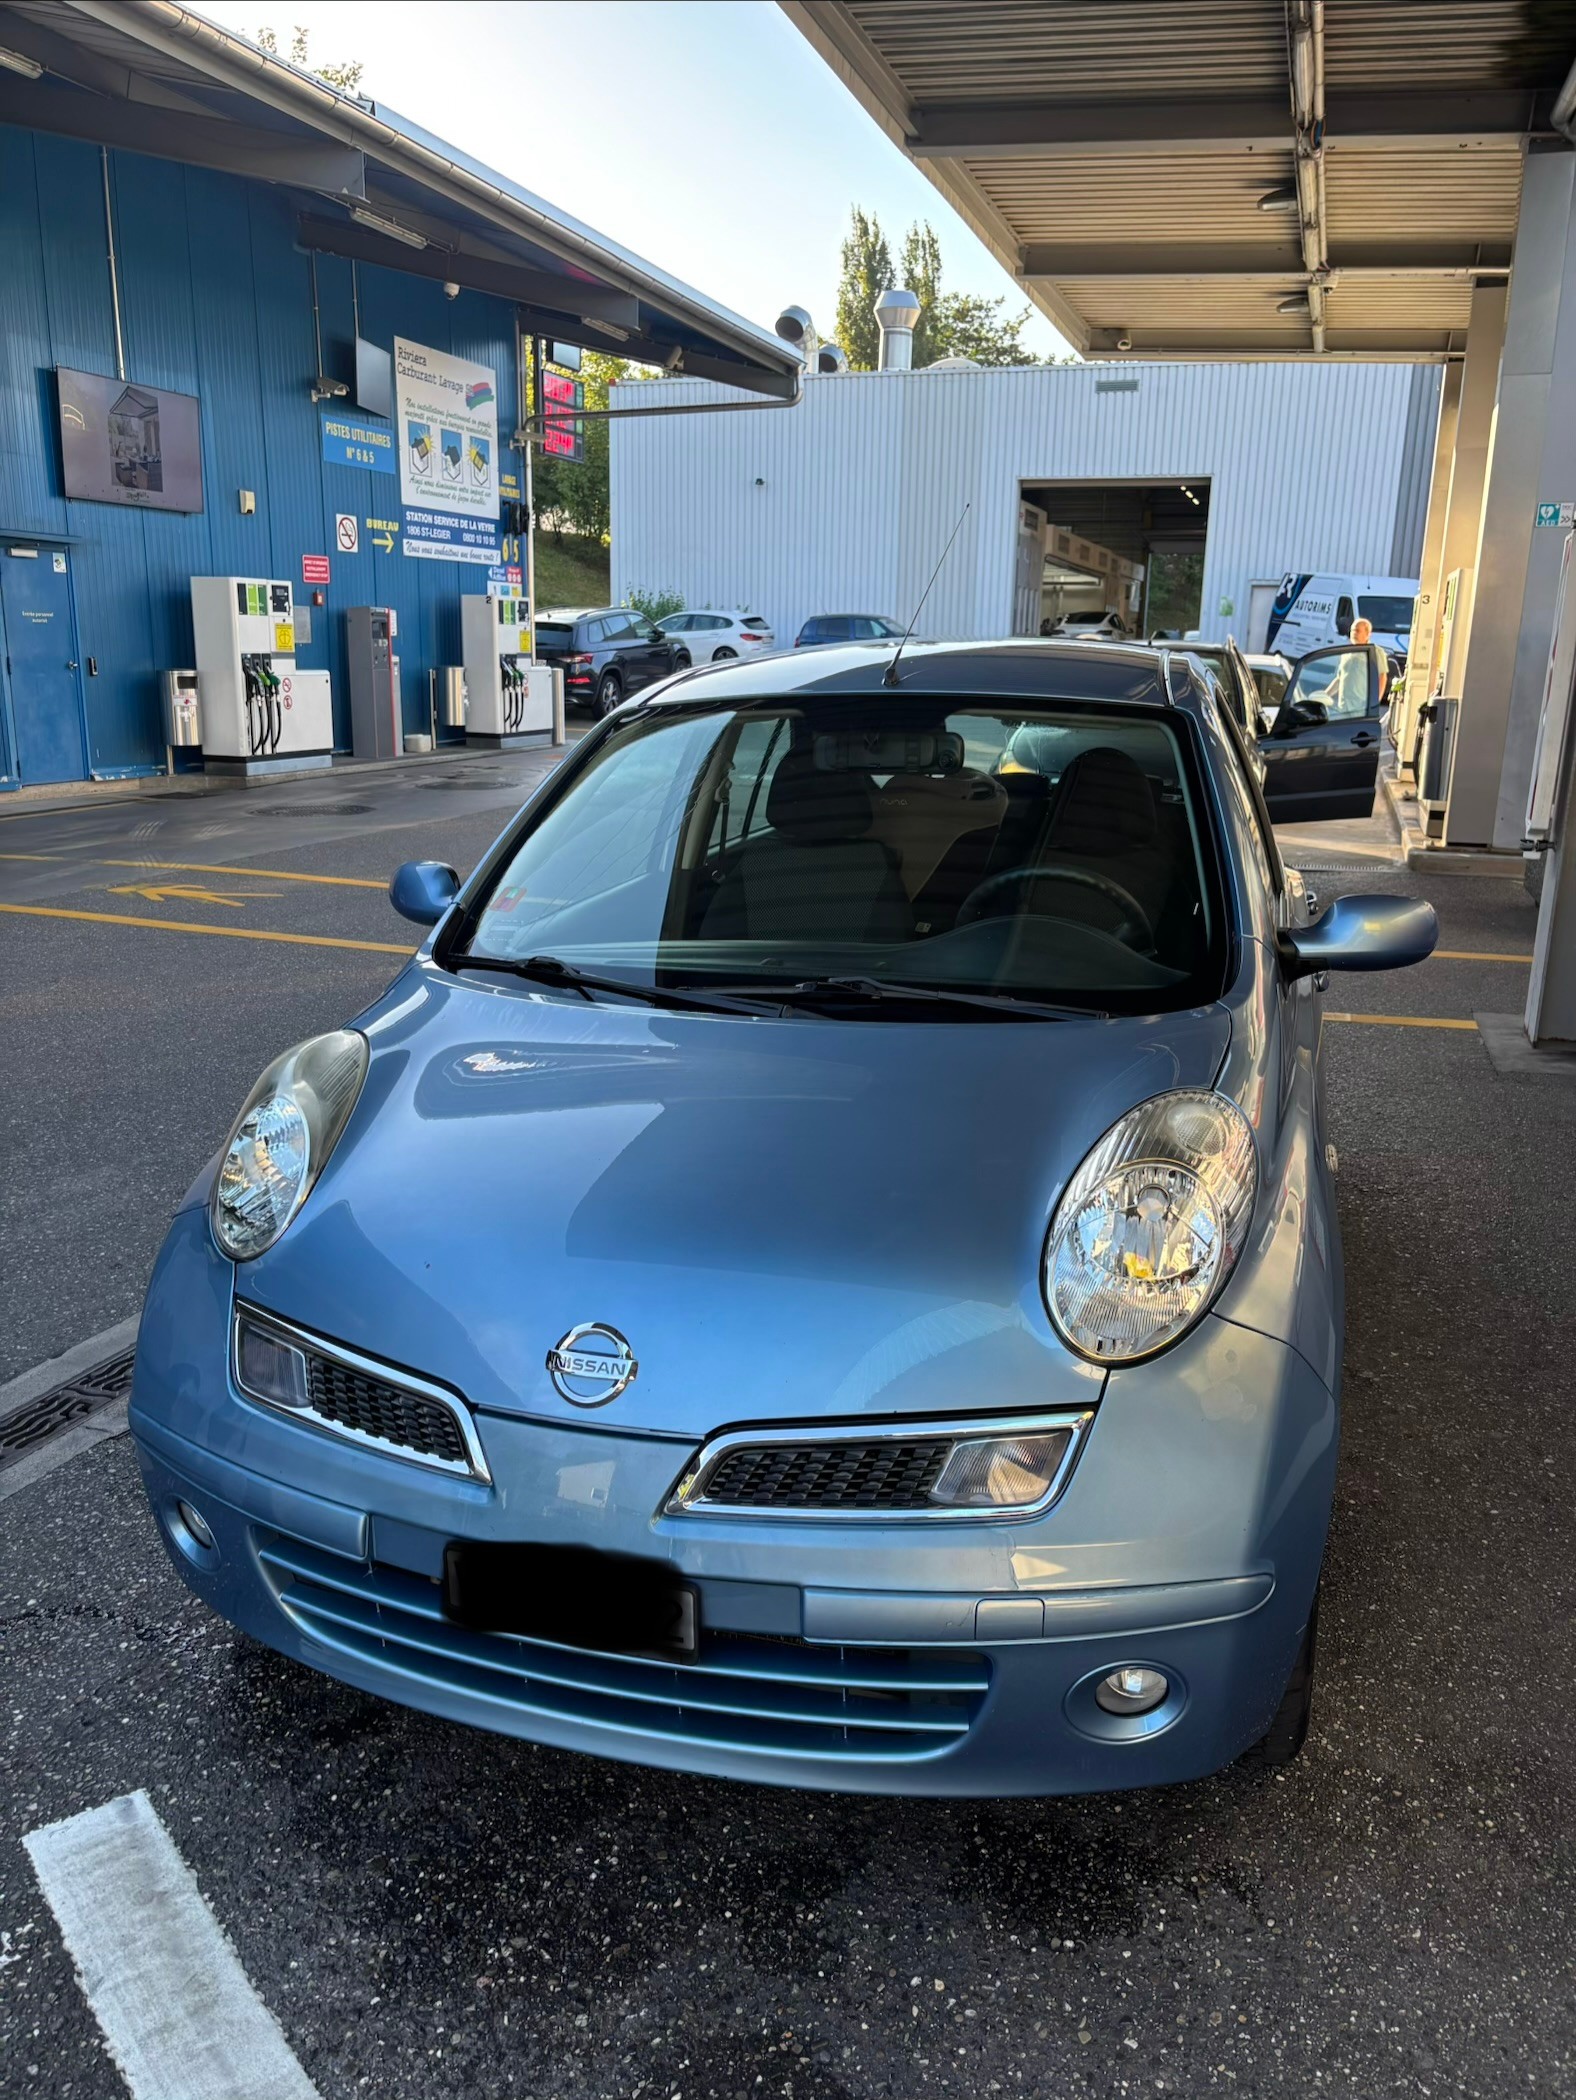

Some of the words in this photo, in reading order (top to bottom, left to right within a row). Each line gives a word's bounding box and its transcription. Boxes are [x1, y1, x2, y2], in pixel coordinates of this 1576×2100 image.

[398, 347, 427, 366] Riviera
[397, 362, 438, 384] Carburant
[439, 375, 464, 394] Lavage
[326, 422, 351, 440] PISTES
[352, 426, 392, 448] UTILITAIRES
[356, 449, 362, 461] 6
[362, 450, 369, 462] &
[369, 452, 374, 464] 5
[366, 518, 399, 532] BUREAU
[406, 511, 432, 524] STATION
[434, 515, 459, 528] SERVICE
[460, 519, 468, 529] DE
[469, 520, 477, 530] LA
[478, 521, 496, 533] VEYRE
[406, 526, 420, 536] 1806
[421, 528, 451, 540] ST-LEGIER
[462, 533, 476, 543] 0800
[476, 535, 482, 544] 10
[483, 536, 489, 545] 10
[489, 537, 496, 546] 95
[502, 538, 509, 562] 6
[513, 539, 519, 563] 5
[486, 596, 492, 604] 2
[1295, 600, 1332, 614] AUTORIMS
[1422, 594, 1430, 604] 3
[553, 1354, 626, 1376] NISSAN
